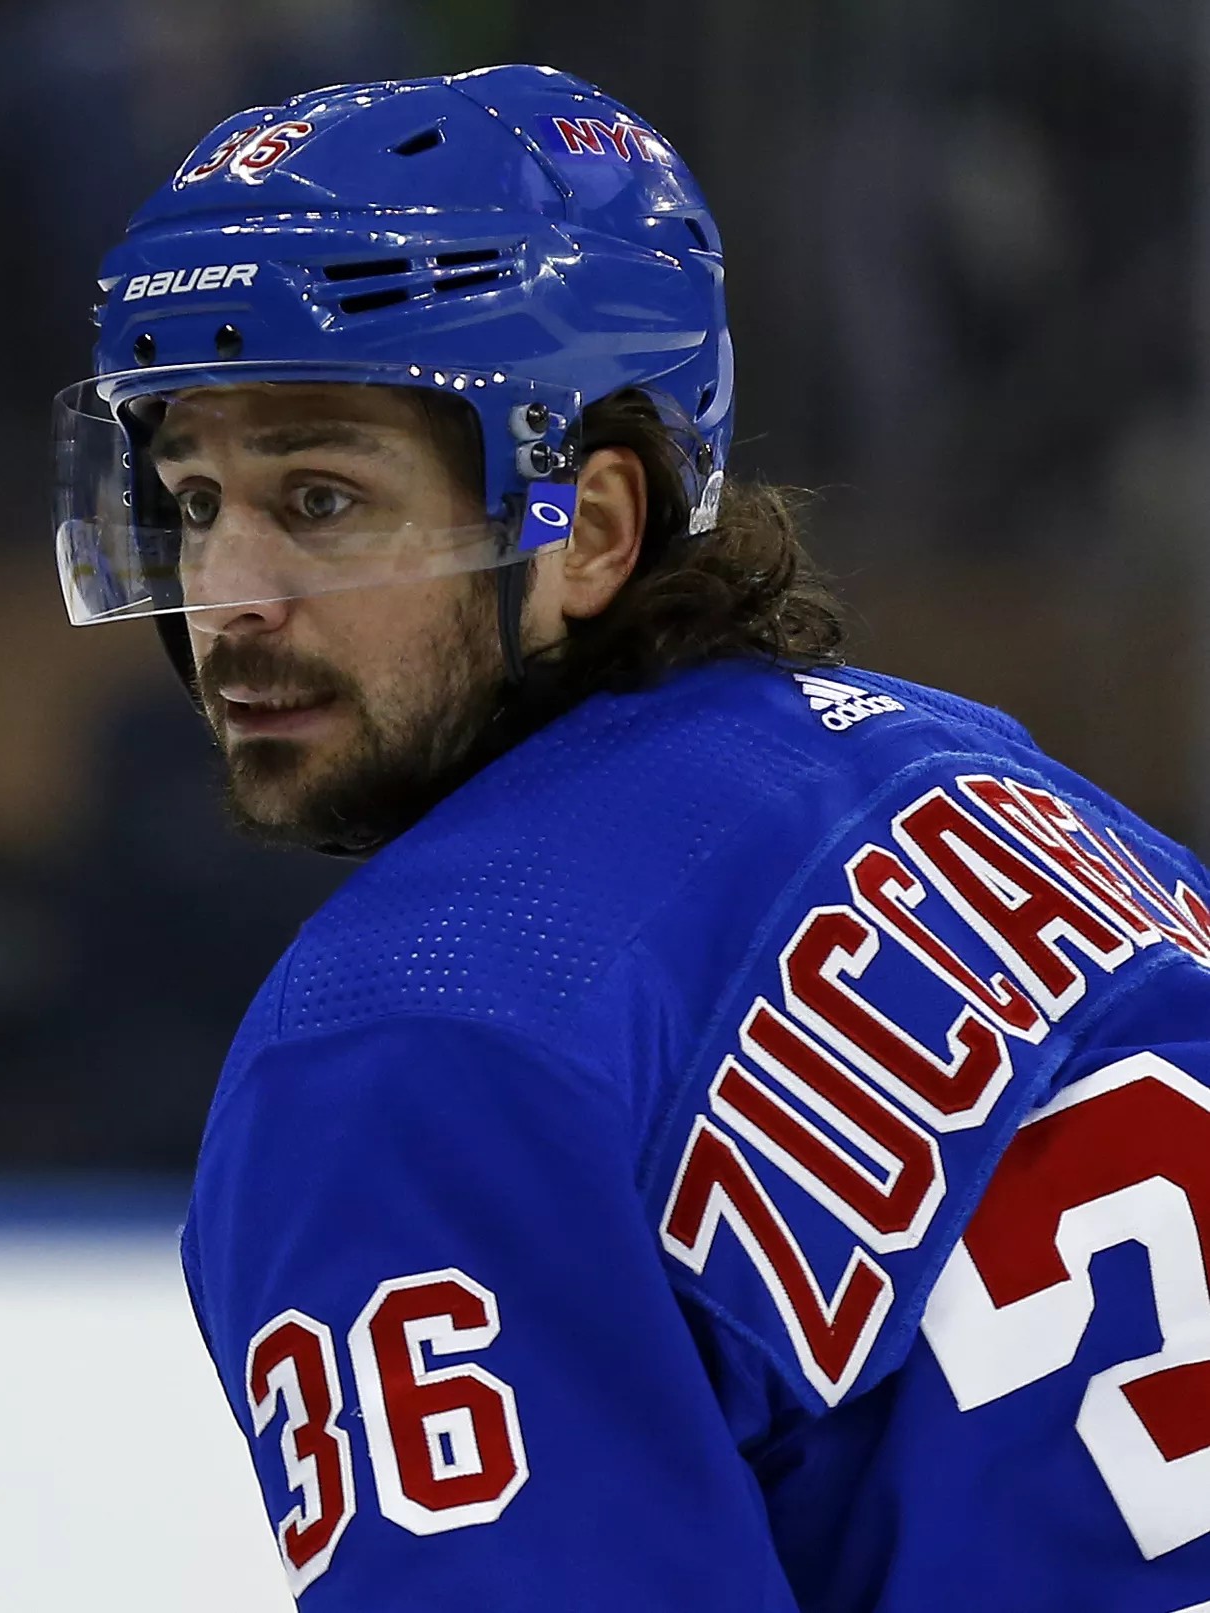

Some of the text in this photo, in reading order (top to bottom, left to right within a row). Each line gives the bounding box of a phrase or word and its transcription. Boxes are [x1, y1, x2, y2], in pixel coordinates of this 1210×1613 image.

[186, 120, 312, 184] 36
[552, 117, 671, 167] NYR
[821, 695, 905, 731] adidas
[246, 1267, 530, 1598] 36
